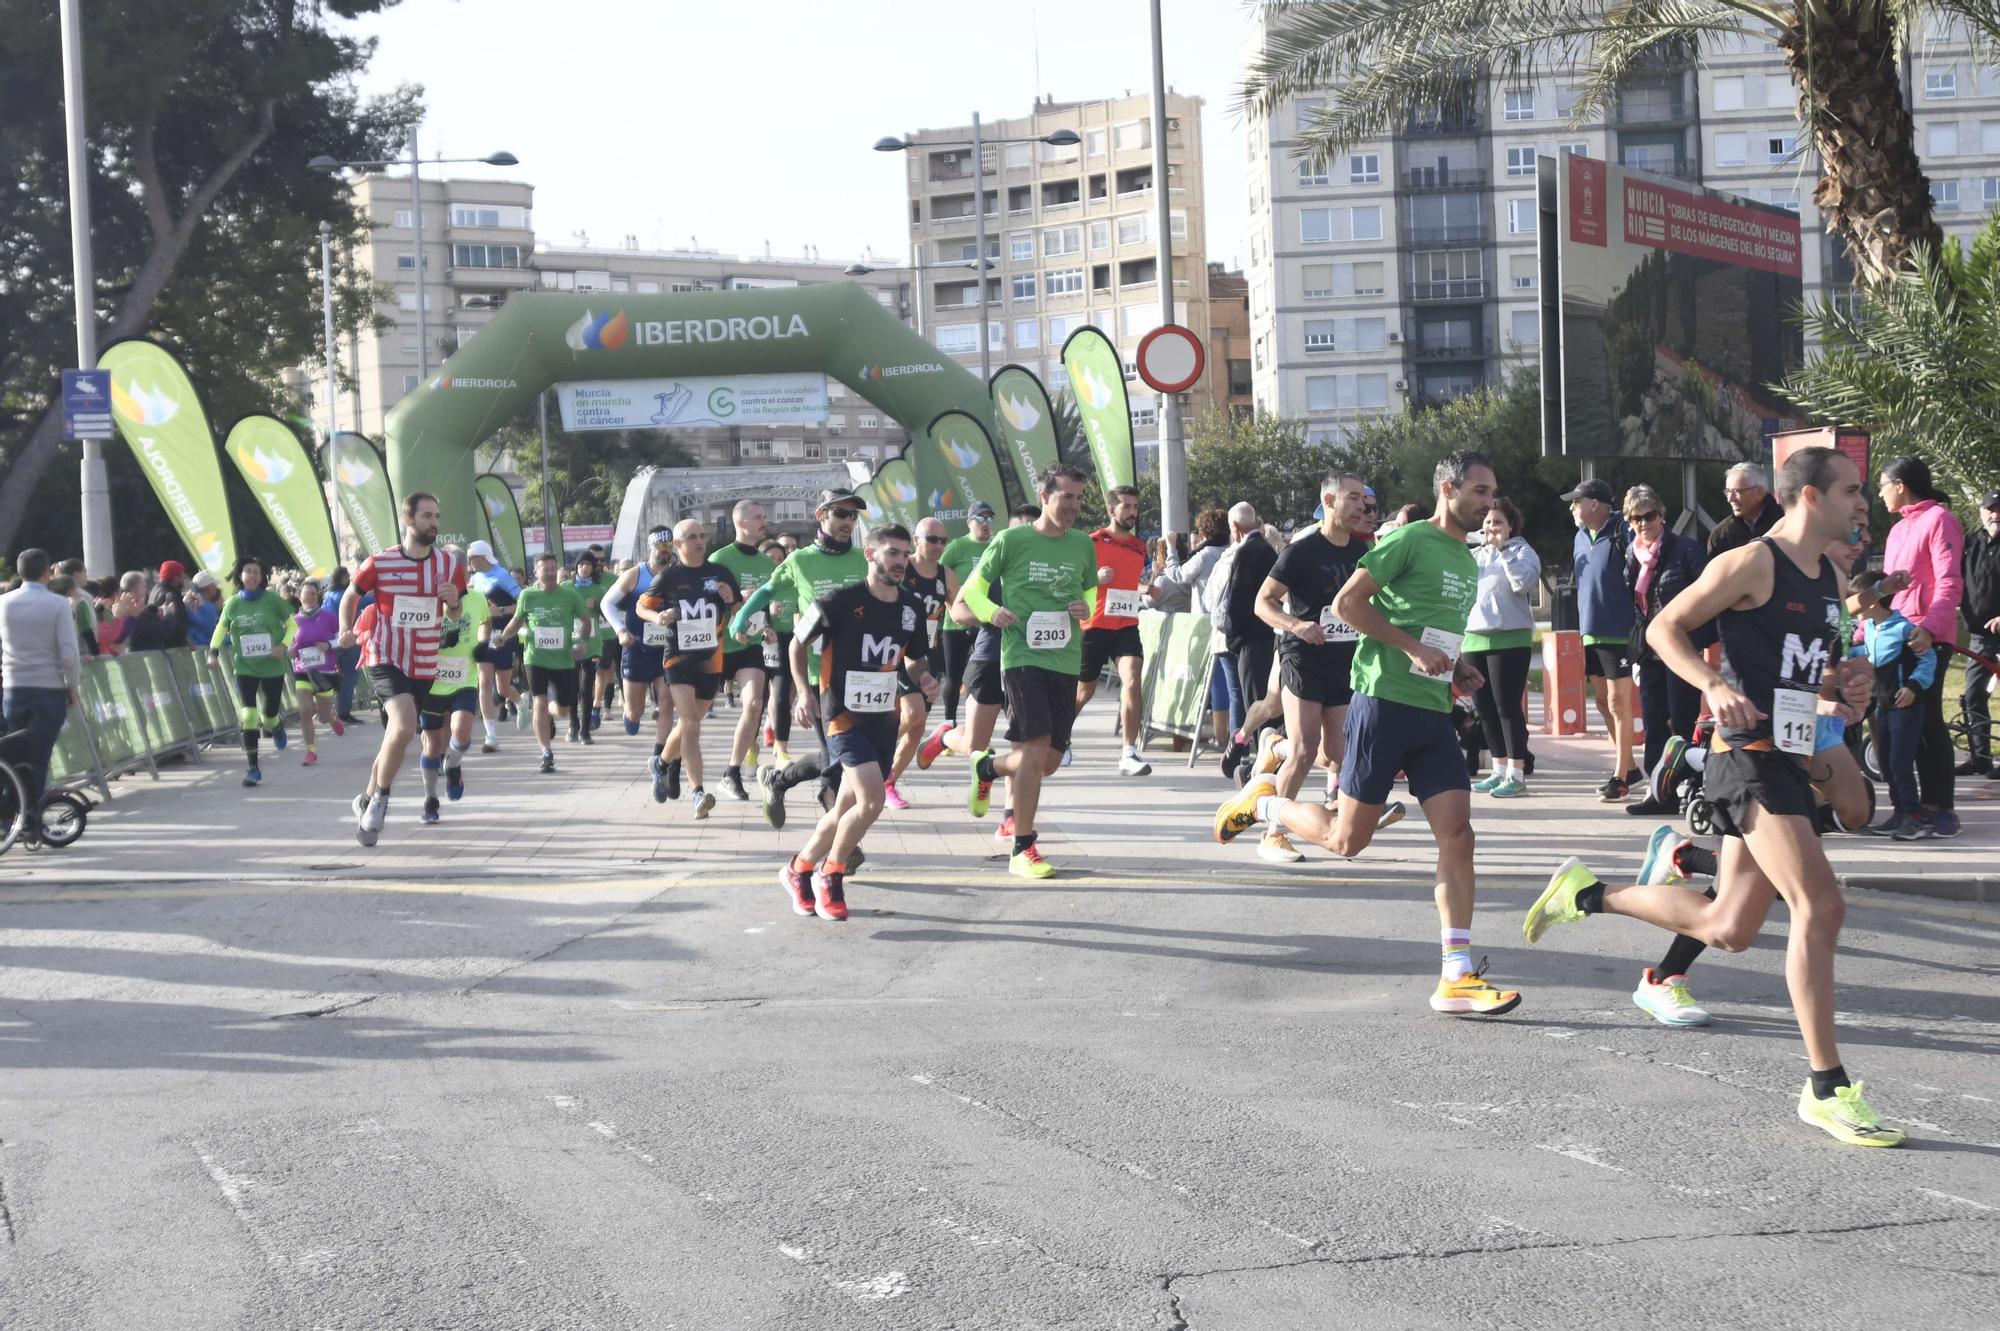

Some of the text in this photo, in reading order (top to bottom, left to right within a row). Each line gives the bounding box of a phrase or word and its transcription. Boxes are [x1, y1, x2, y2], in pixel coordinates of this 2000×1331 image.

[1627, 187, 1665, 216] MURCIA
[1628, 213, 1644, 237] RIO
[1697, 211, 1709, 225] DE
[1709, 213, 1762, 238] REVEGETACIÓN
[1762, 227, 1768, 239] Y
[1768, 228, 1796, 247] MEJORA
[1670, 224, 1681, 239] DE
[1682, 227, 1697, 243] LOS
[1699, 229, 1739, 252] MÁRGENES
[1740, 240, 1753, 254] DEL
[1754, 241, 1767, 257] RÍO
[635, 314, 809, 345] IBERDROLA
[881, 363, 944, 377] IBERDROLA
[451, 378, 517, 389] IBERDROLA
[575, 388, 611, 398] Murcia
[576, 397, 631, 407] en marcha
[741, 397, 767, 405] contra
[577, 407, 611, 417] contra
[577, 416, 625, 425] el cáncer
[1110, 602, 1133, 611] 2341
[399, 611, 430, 622] 0709
[538, 637, 559, 645] 0001
[684, 633, 712, 644] 2420
[1034, 630, 1066, 641] 2303
[861, 633, 900, 666] Mh
[435, 669, 462, 678] 2203
[854, 692, 891, 704] 1147
